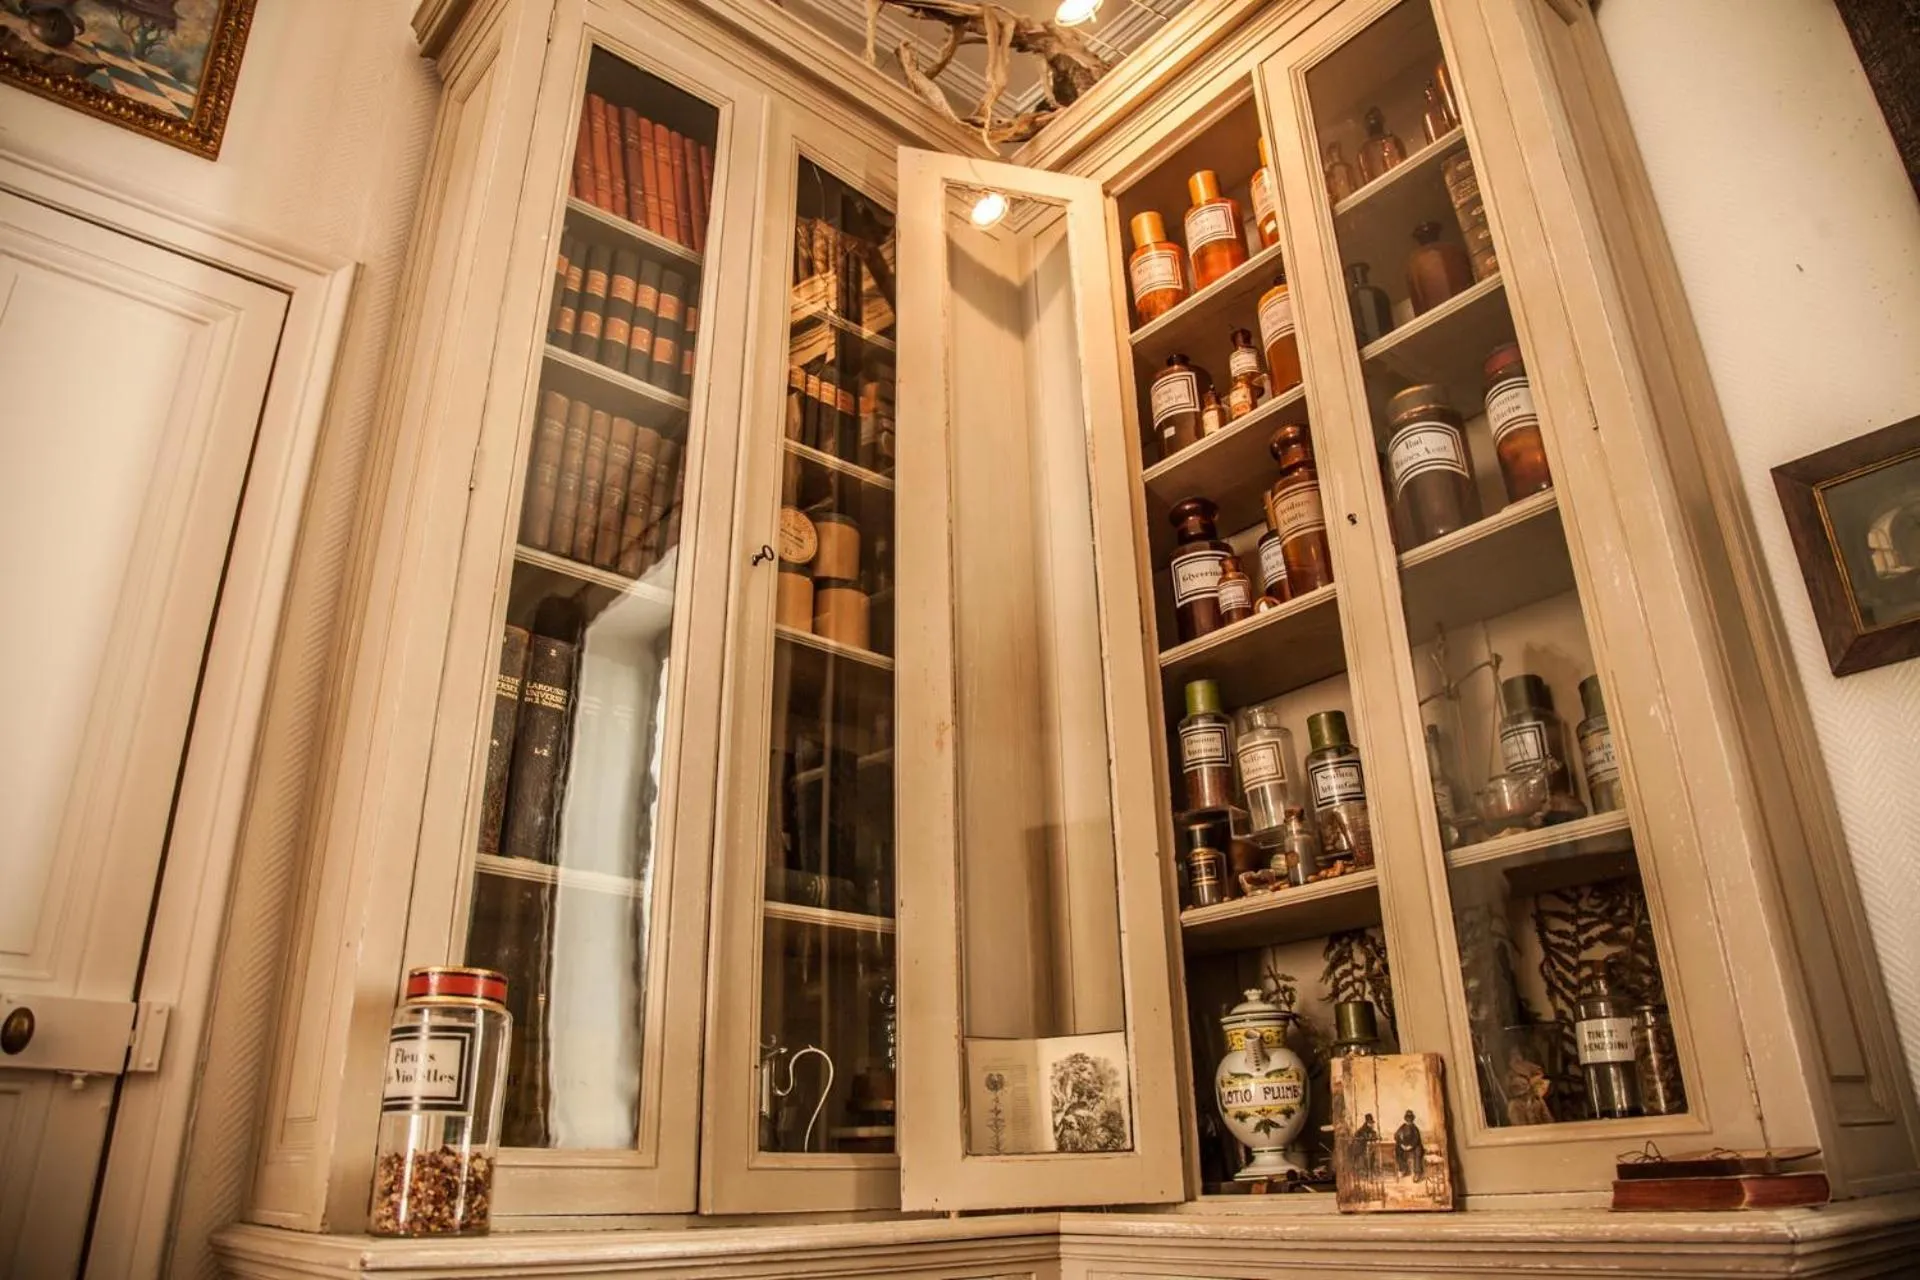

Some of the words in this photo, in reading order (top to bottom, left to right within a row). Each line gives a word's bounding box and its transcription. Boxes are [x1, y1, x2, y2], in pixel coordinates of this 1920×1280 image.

[1182, 571, 1222, 583] Glycerin
[394, 1048, 436, 1064] Fleus
[396, 1069, 456, 1083] Viottes
[1263, 1086, 1301, 1101] PLUMB
